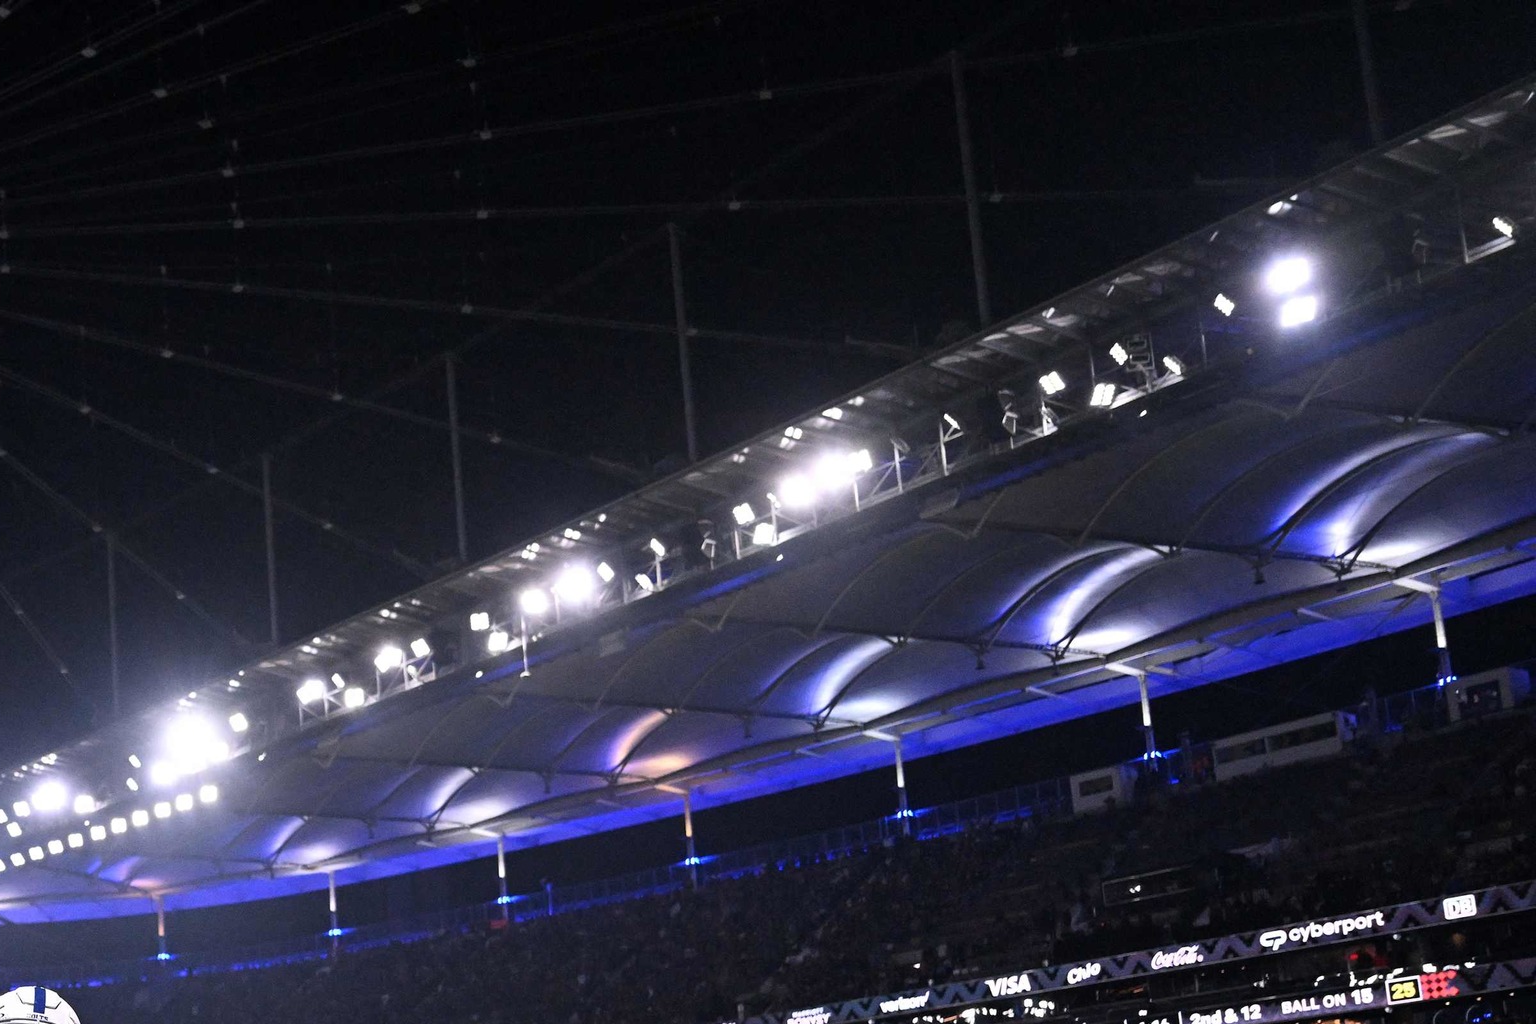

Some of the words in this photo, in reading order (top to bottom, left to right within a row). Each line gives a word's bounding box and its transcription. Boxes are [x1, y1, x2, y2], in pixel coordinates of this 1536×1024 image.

[1447, 895, 1474, 918] DB
[1288, 911, 1385, 942] cyberport
[984, 974, 1032, 997] VISA
[1067, 963, 1101, 985] Chio
[1390, 982, 1417, 1000] 25
[1224, 1008, 1238, 1024] &
[1240, 1004, 1262, 1022] 12
[1281, 997, 1320, 1016] BALL
[1322, 993, 1347, 1010] ON
[1351, 987, 1374, 1005] 15
